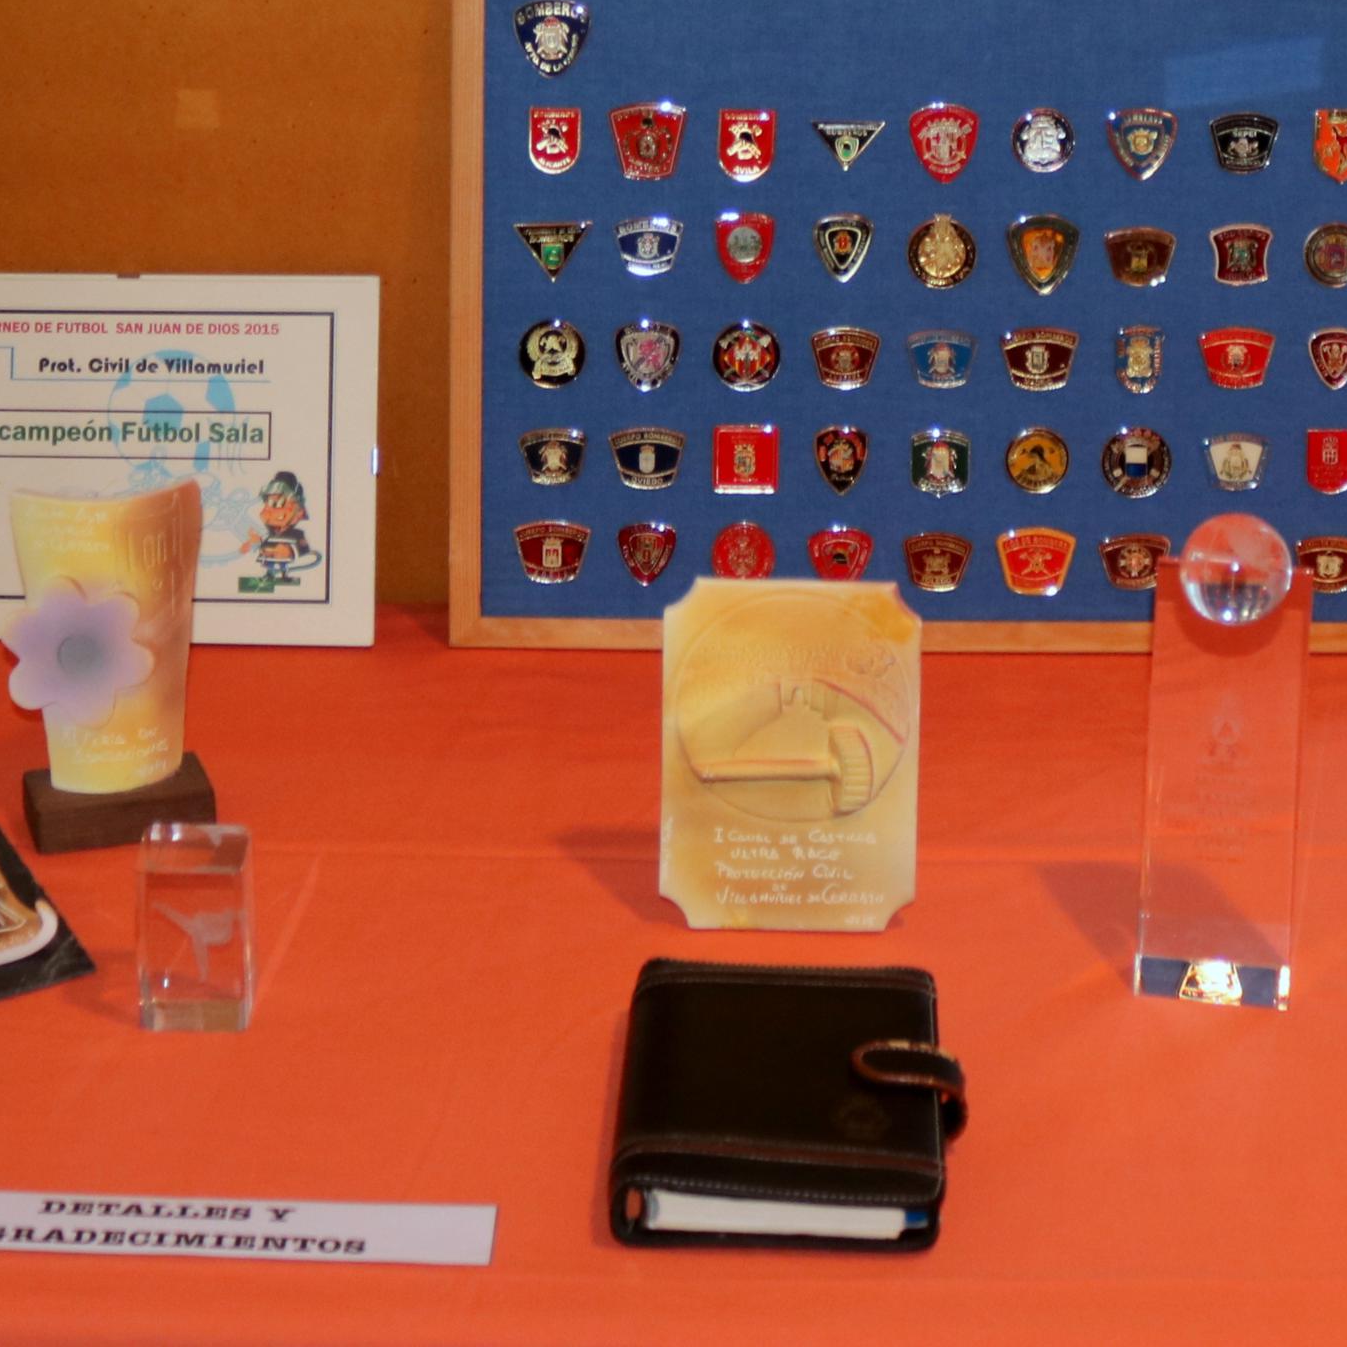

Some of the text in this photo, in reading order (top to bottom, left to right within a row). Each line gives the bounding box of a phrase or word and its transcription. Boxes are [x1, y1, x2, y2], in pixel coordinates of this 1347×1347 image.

[34, 321, 52, 333] DE
[56, 322, 108, 334] FUTBOL
[116, 323, 143, 334] SAN
[148, 323, 181, 334] JUAN
[185, 323, 203, 334] DE
[208, 323, 240, 335] DIOS
[244, 323, 279, 335] 2015
[39, 357, 264, 374] Prot. Civil de Villamuriel
[120, 418, 200, 443] Fútbol
[209, 422, 264, 443] Sala
[631, 476, 664, 486] OVIEDO
[714, 828, 724, 843] I
[39, 1199, 297, 1223] DETALLES Y
